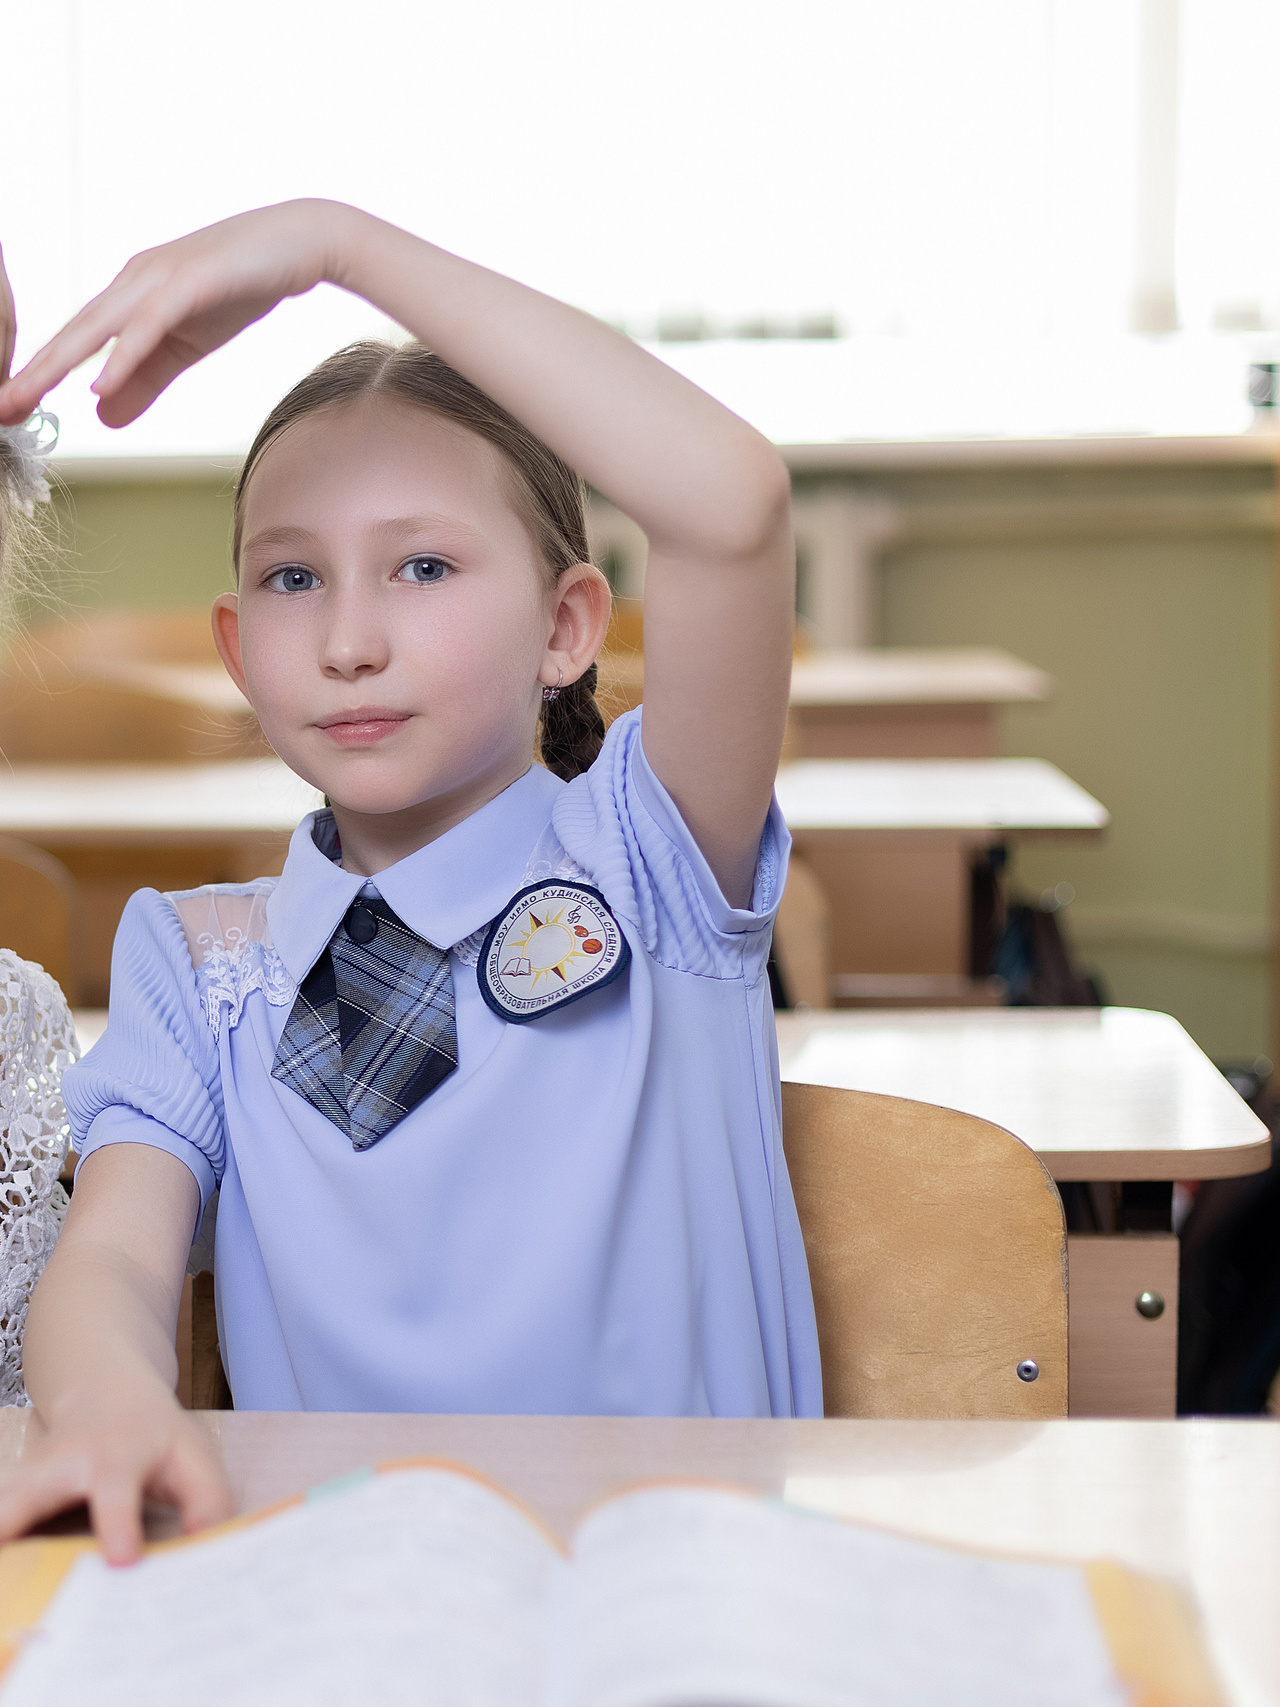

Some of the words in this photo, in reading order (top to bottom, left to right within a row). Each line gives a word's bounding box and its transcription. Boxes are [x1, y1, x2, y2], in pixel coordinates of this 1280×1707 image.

[511, 895, 537, 920] ИРМО
[543, 889, 606, 918] КУДИНСКАЯ
[495, 925, 508, 947] МОУ
[604, 921, 617, 963] СРЕДНЯЯ
[489, 954, 569, 1009] ОБЩЕОБРАЗОВАТЕЛЬНАЯ
[572, 967, 606, 989] ШКОЛА
